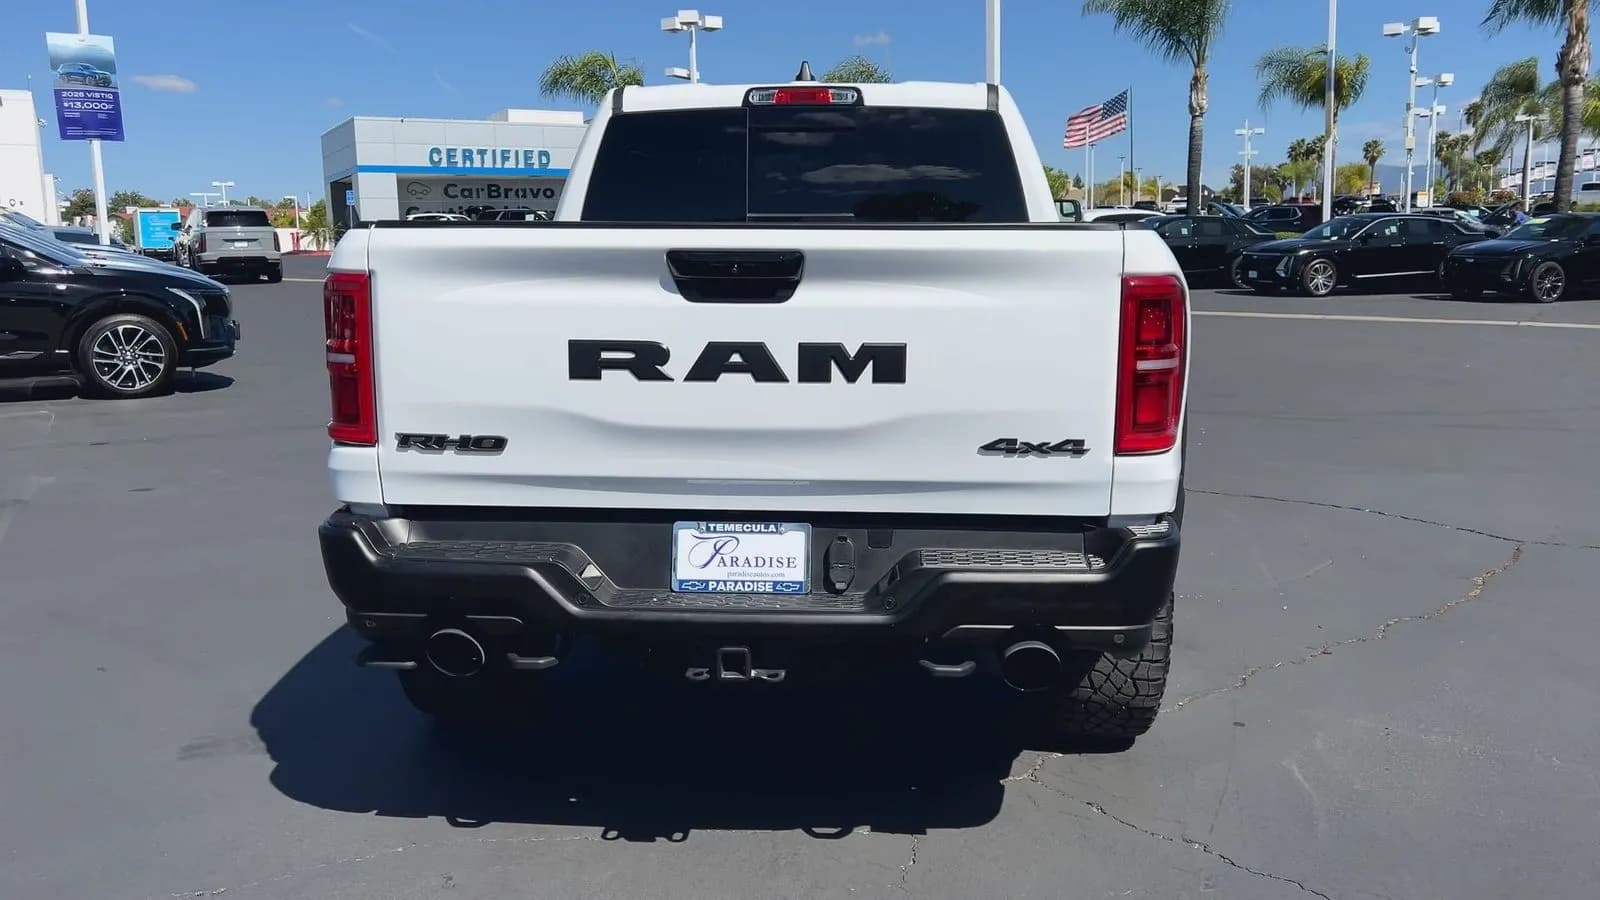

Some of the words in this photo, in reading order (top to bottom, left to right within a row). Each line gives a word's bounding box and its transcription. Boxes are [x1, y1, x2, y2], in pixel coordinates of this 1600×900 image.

[428, 146, 551, 169] CERTIFIED
[443, 183, 555, 199] CarBravo
[568, 339, 908, 384] RAM
[395, 432, 509, 455] RHO
[977, 438, 1091, 458] 4x4
[708, 523, 777, 533] TEMECULA
[726, 571, 786, 579] paradiseautos.com
[708, 581, 774, 592] PARADISE
